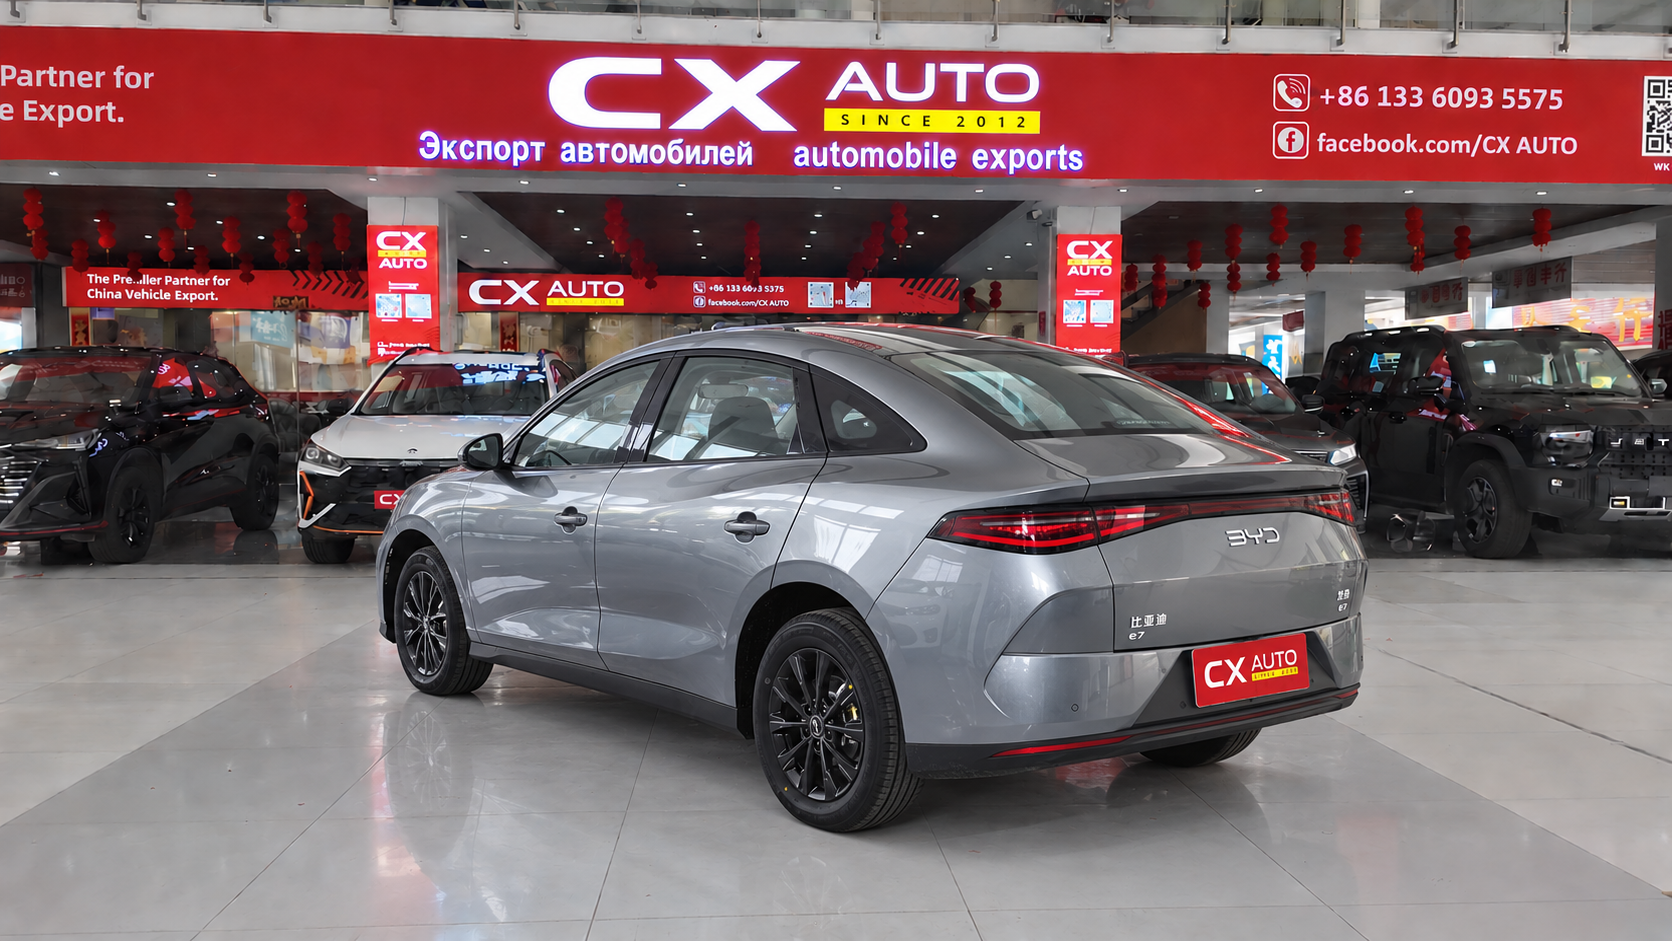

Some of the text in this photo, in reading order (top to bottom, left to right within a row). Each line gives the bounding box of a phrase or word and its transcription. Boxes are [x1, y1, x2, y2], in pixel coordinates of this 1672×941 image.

[1, 65, 155, 89] Partner for
[548, 56, 1040, 132] CX AUTO
[1319, 85, 1564, 110] +86 133 6093 5575
[24, 100, 124, 128] Export.
[841, 113, 1025, 128] SINCE 2012
[418, 131, 754, 167] Экспорт автомобилей
[1317, 133, 1578, 158] facebook.com/CX AUTO
[793, 141, 1084, 174] automobile exports
[376, 231, 427, 251] CX
[1066, 240, 1113, 260] CX
[378, 258, 428, 269] AUTO
[1067, 265, 1113, 276] AUTO
[86, 273, 110, 284] The
[164, 275, 211, 286] Partner
[212, 275, 231, 286] for
[726, 284, 741, 292] 133
[86, 288, 219, 303] China Vehicle Export.
[468, 279, 625, 306] CX AUTO
[1225, 527, 1280, 547] BYD
[1204, 656, 1248, 689] CX
[1251, 649, 1298, 672] AUTO
